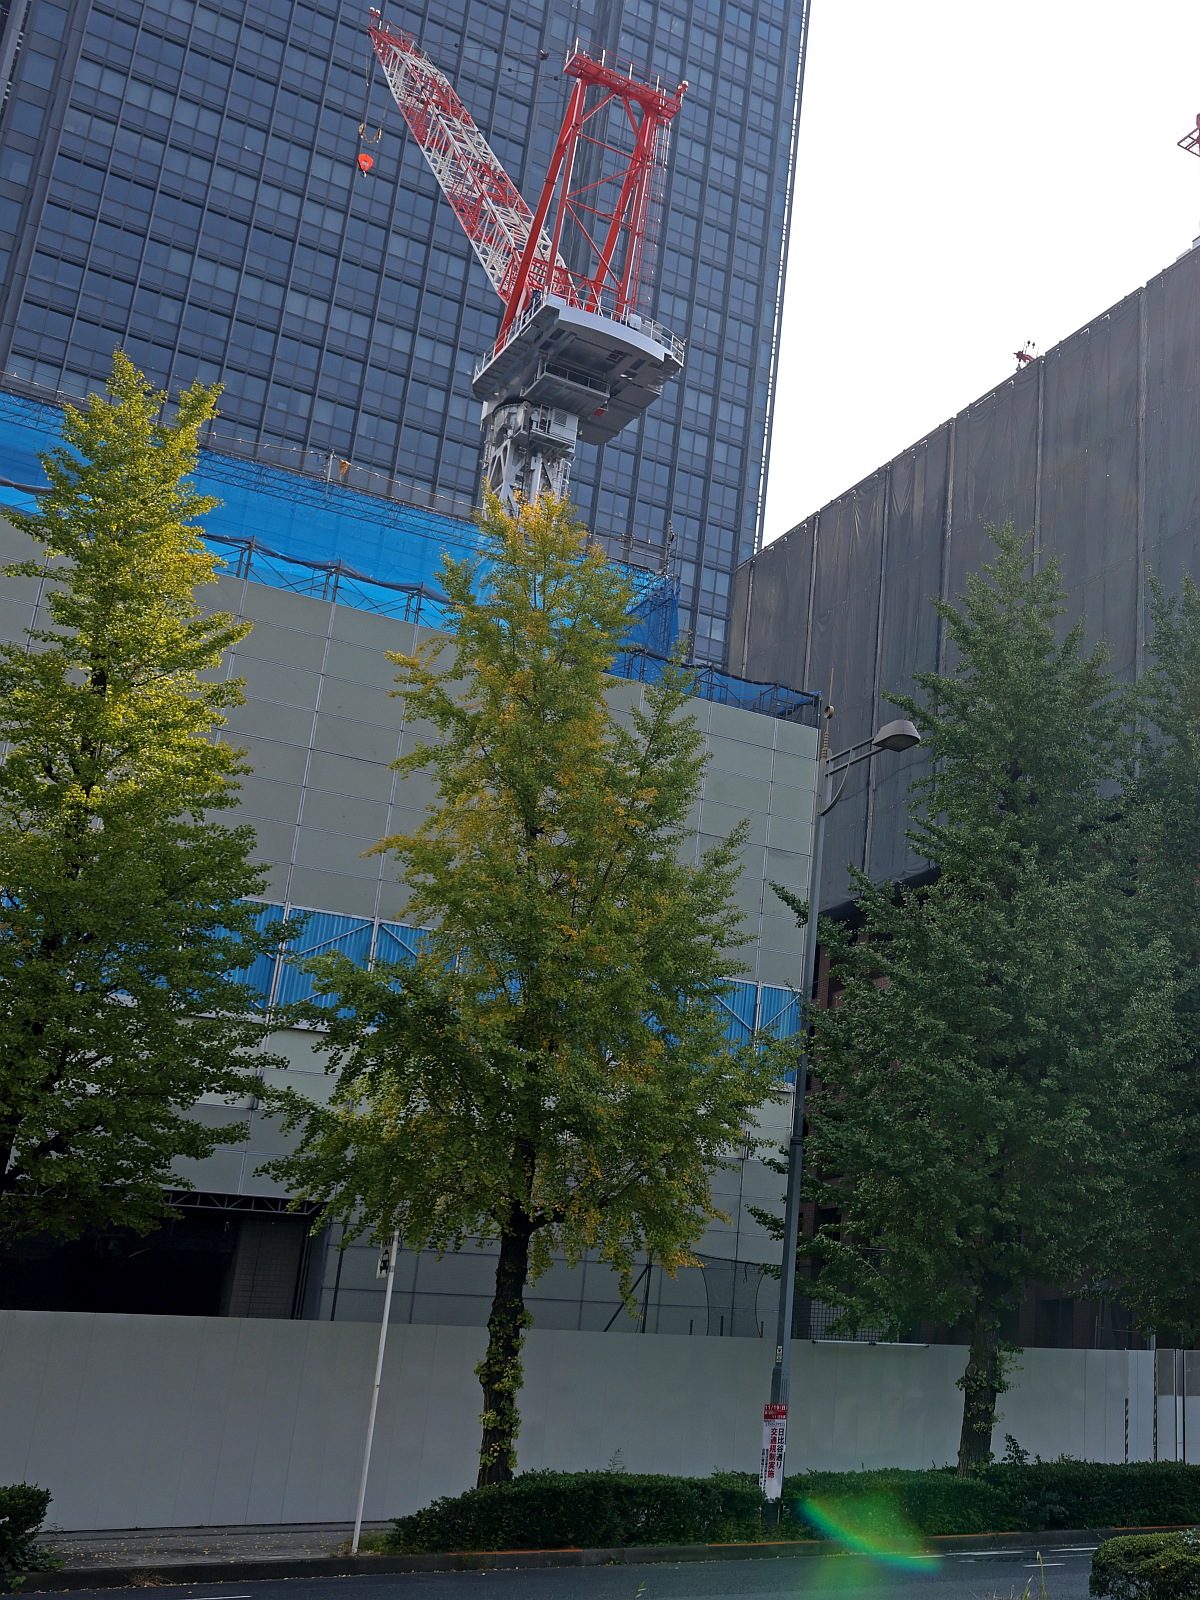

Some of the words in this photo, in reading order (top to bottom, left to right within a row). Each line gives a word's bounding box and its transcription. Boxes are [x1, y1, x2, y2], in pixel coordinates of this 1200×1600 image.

[768, 1427, 778, 1478] 交通規制実施
[776, 1428, 785, 1469] 日比谷通り
